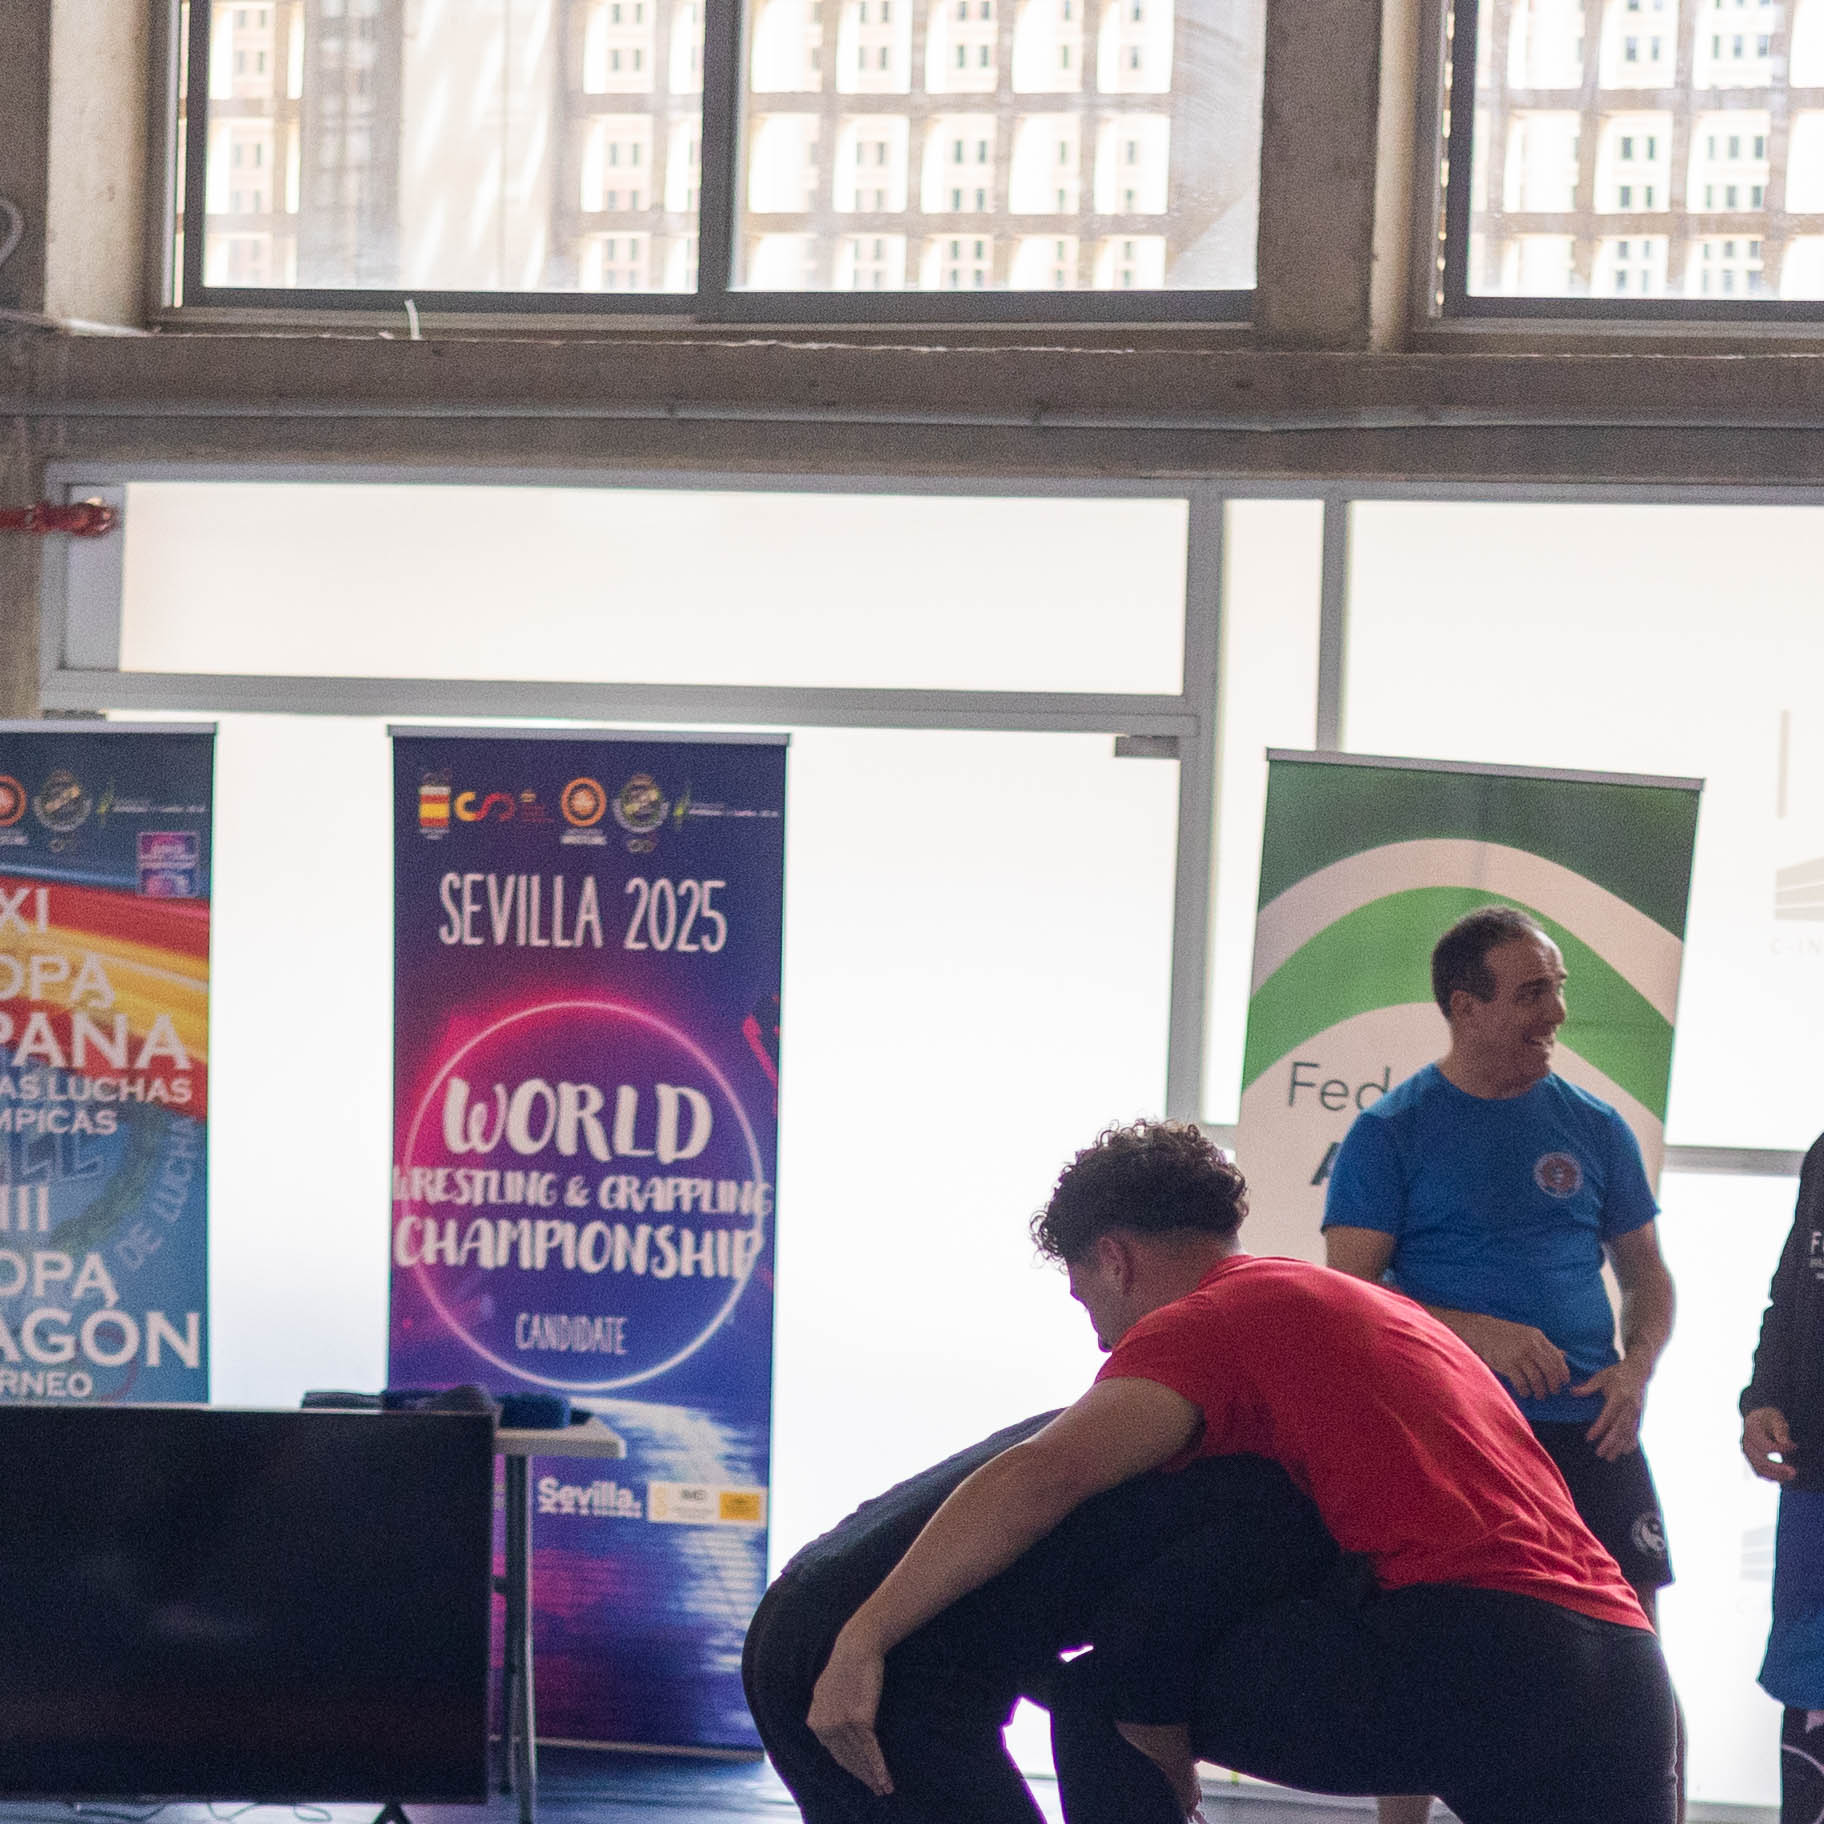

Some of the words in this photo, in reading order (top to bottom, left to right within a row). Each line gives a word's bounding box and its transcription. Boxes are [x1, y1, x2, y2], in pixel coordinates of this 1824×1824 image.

[439, 872, 604, 950] SEVILLA
[624, 876, 728, 954] 2025
[48, 1075, 193, 1104] LUCHAS
[1287, 1061, 1391, 1112] Fed
[443, 1077, 713, 1165] WORLD
[563, 1174, 590, 1208] &
[598, 1175, 773, 1217] GRAPPLING
[393, 1215, 763, 1281] CHAMPIONSHIP
[515, 1313, 628, 1355] CANDIDATE
